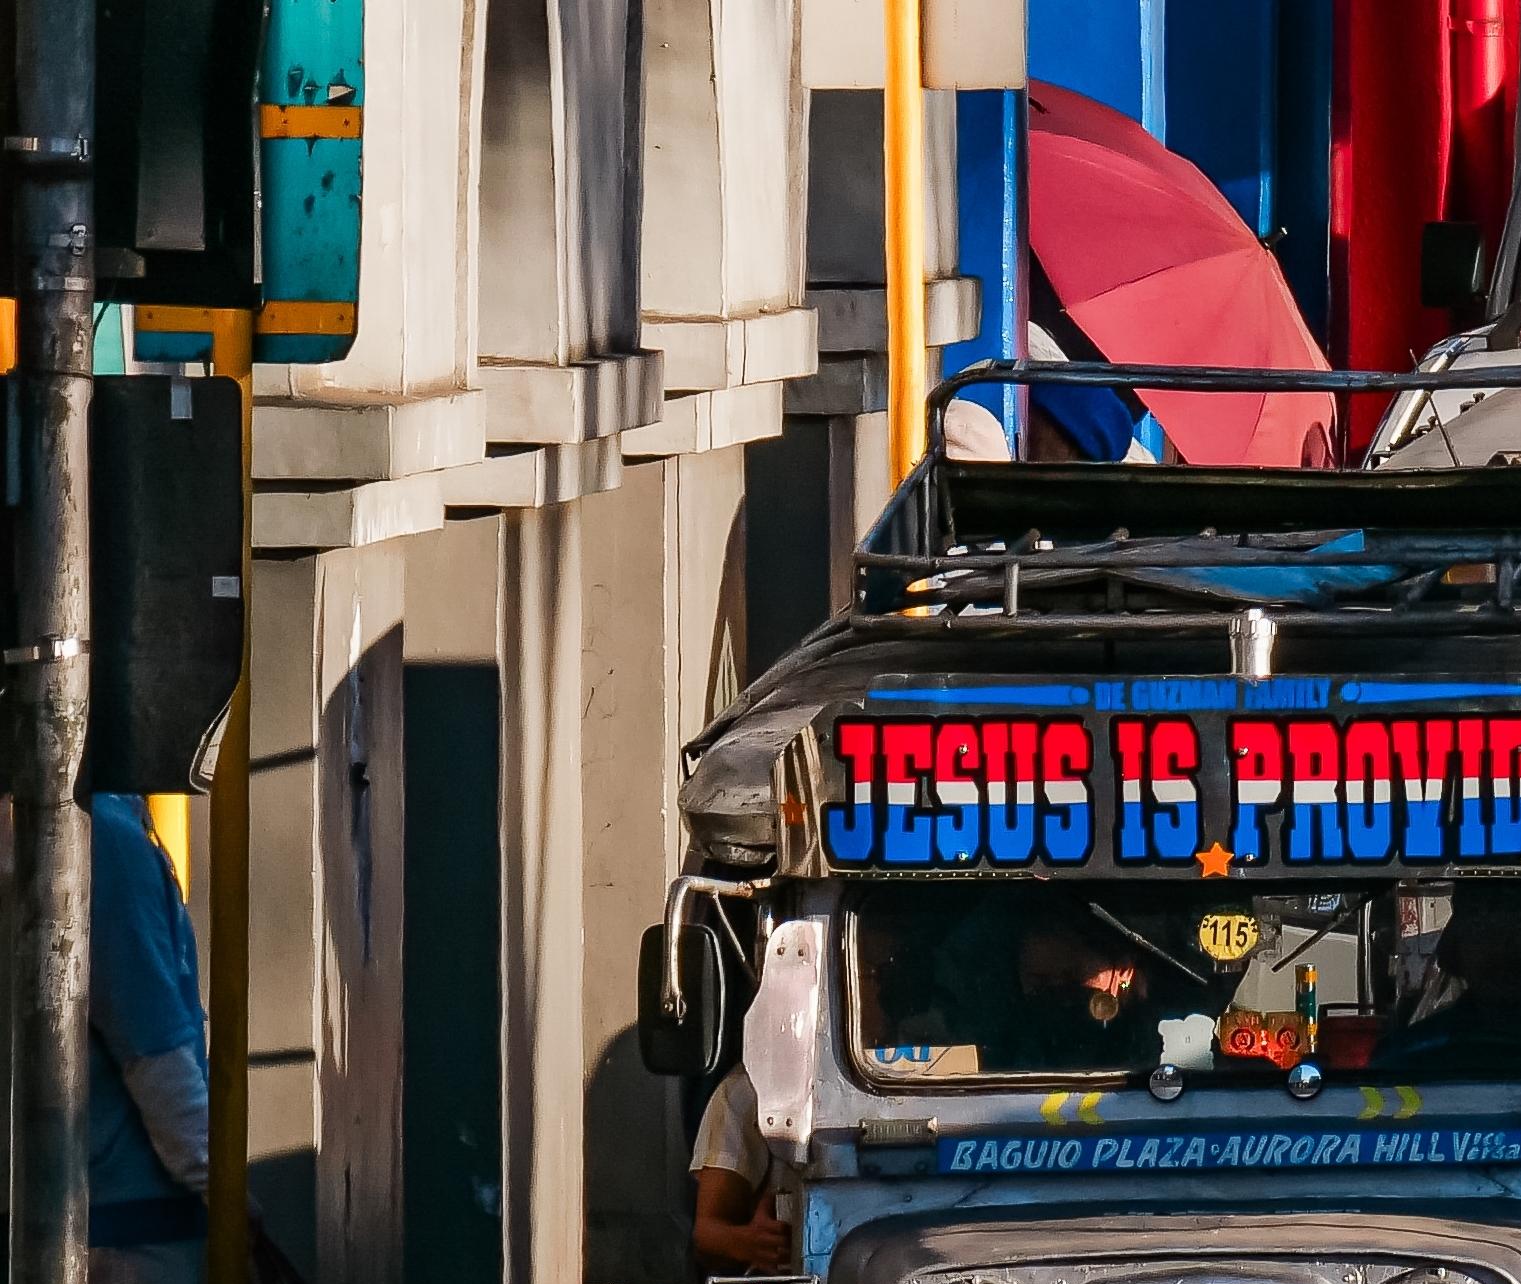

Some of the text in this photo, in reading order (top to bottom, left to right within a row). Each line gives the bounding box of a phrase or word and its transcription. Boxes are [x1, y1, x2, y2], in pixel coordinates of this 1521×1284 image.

[827, 720, 1090, 863] JESUS
[1116, 720, 1200, 861] IS
[1209, 920, 1249, 947] 115
[950, 1139, 1083, 1170] BAGUIO
[1372, 1132, 1446, 1162] HILL
